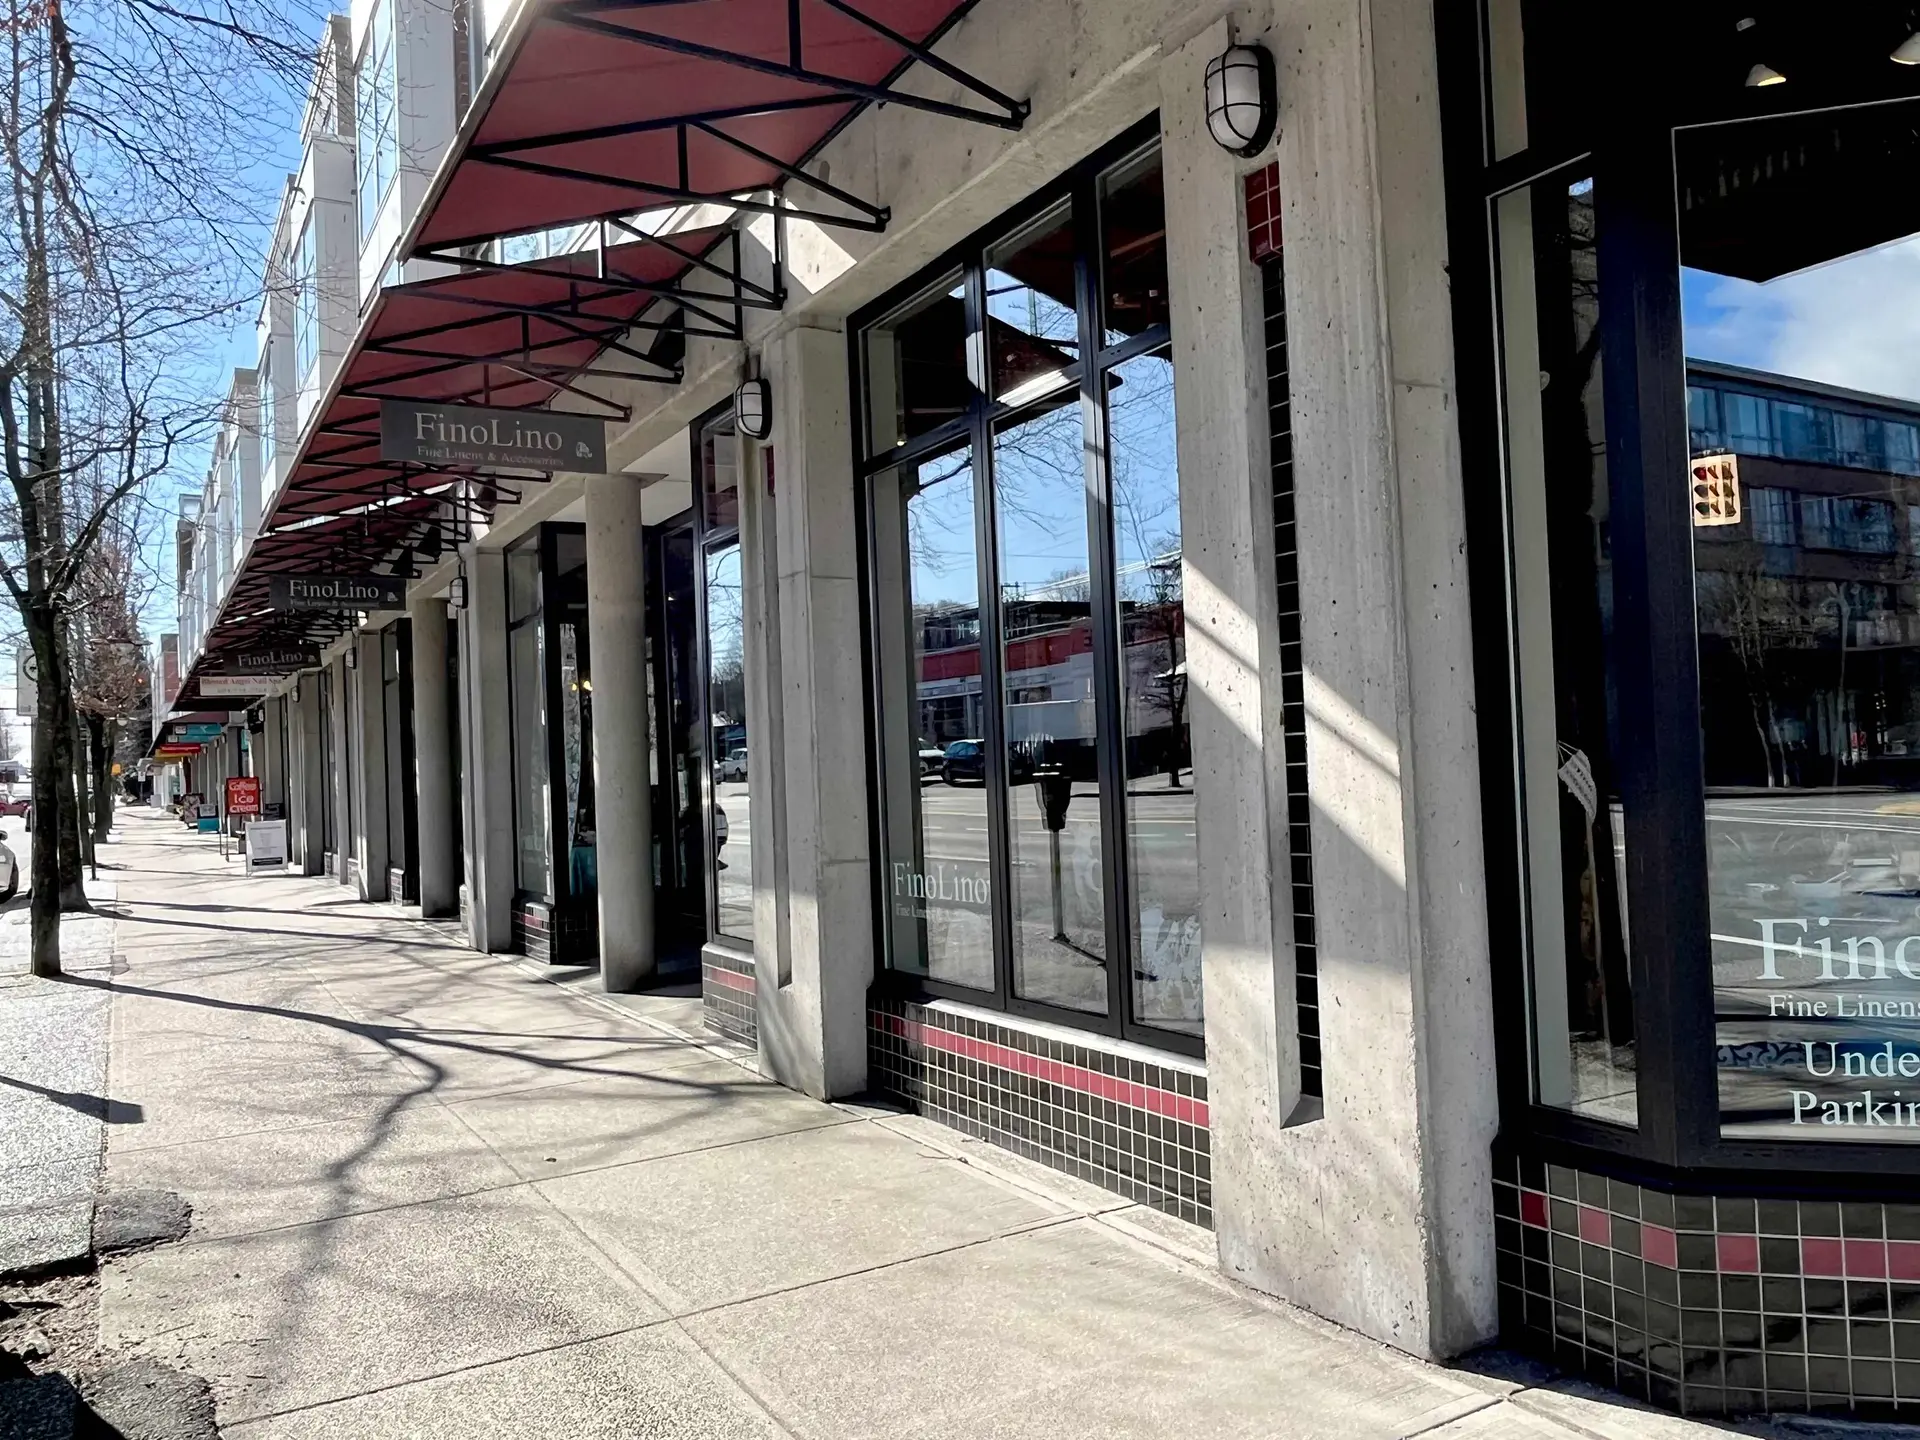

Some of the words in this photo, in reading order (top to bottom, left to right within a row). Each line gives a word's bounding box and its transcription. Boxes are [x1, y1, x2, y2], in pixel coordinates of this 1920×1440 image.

[414, 412, 563, 451] FinoLino
[417, 446, 442, 458] Fine
[445, 447, 484, 461] Linens
[487, 452, 497, 462] &
[501, 453, 565, 467] Accessories
[288, 579, 380, 599] FinoLino
[237, 650, 303, 667] FinoLino
[234, 794, 255, 804] Ice
[893, 861, 988, 905] FinoLino
[1768, 994, 1829, 1017] Fine
[1800, 1041, 1920, 1078] Unde
